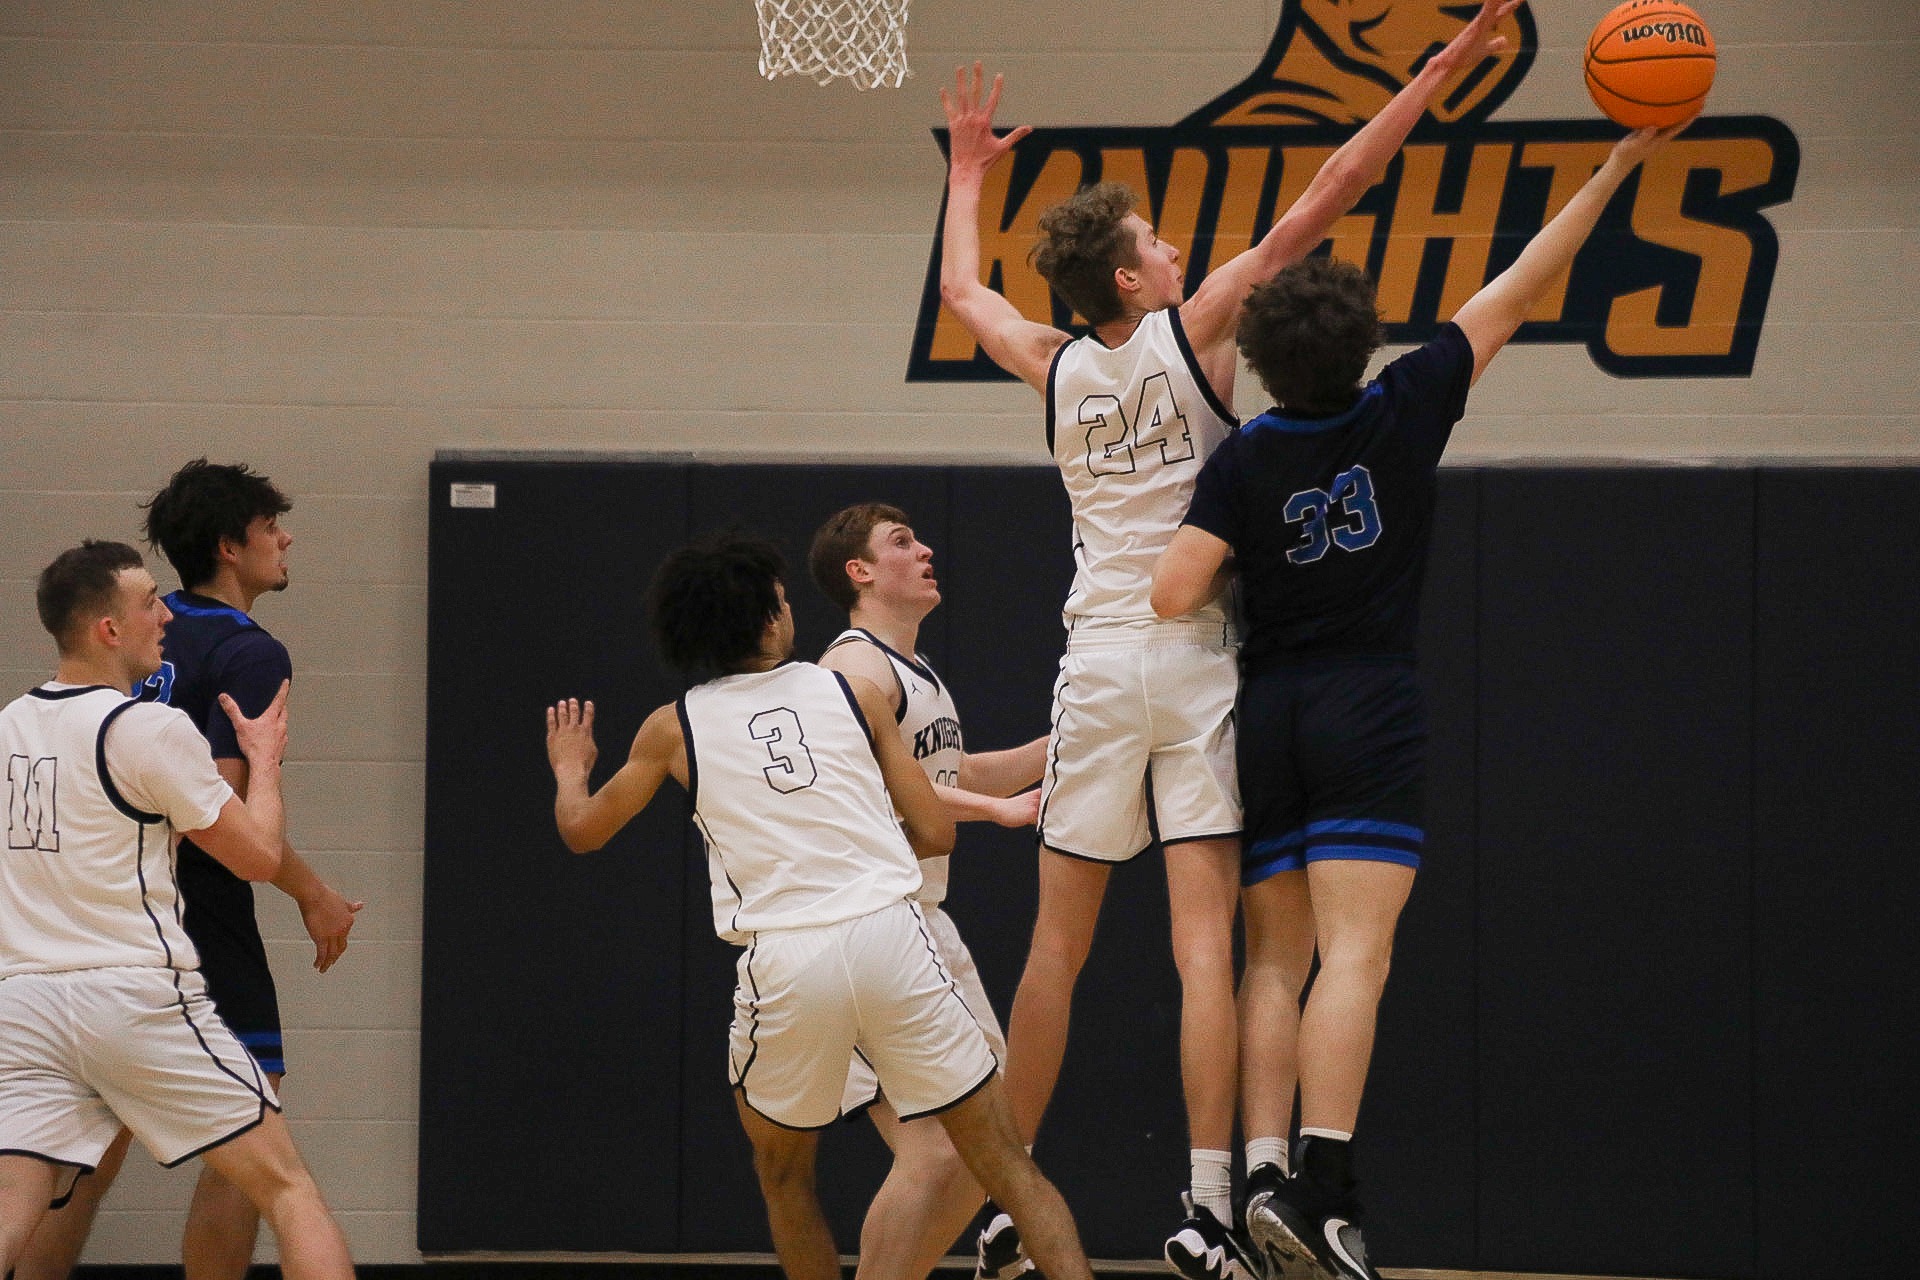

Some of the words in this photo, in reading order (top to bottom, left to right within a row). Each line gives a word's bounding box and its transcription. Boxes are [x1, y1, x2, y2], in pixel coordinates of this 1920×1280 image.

[1622, 22, 1707, 47] Wilson
[1078, 371, 1195, 478] 24
[1283, 464, 1382, 565] 33
[747, 706, 818, 795] 3
[912, 716, 961, 761] KNIGH
[7, 753, 60, 853] 11
